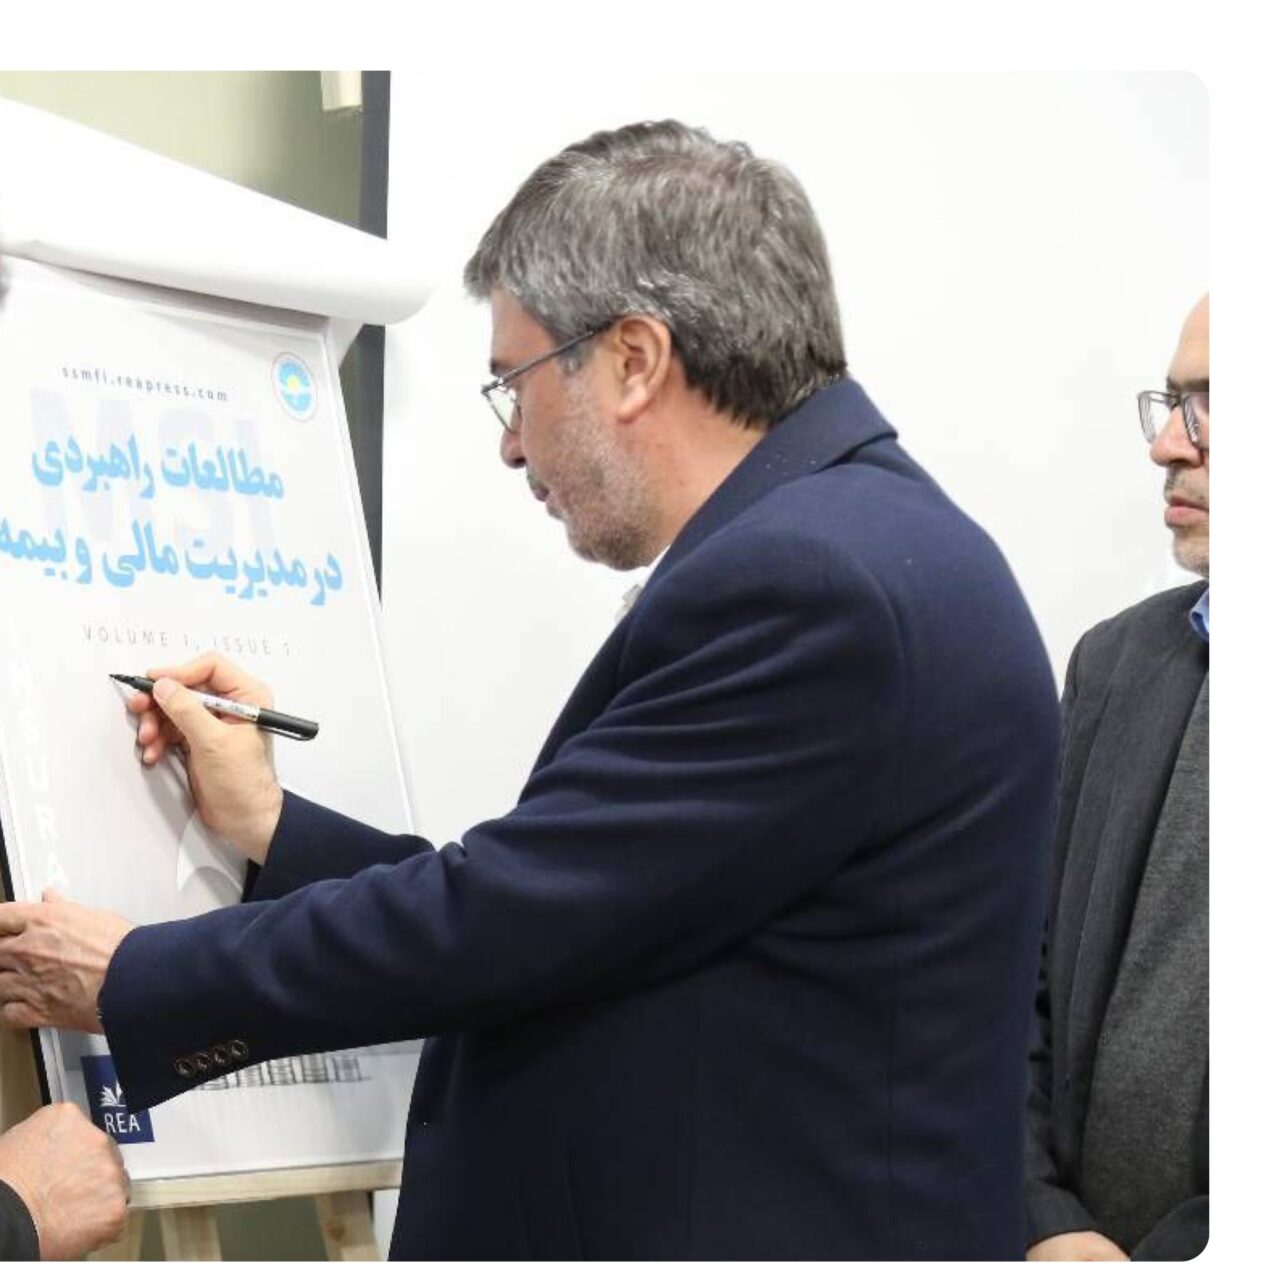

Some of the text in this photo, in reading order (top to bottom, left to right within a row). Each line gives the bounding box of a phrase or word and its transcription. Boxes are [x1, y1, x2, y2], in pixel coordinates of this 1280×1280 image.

[62, 364, 230, 403] ssmfi.reapress.com
[31, 433, 285, 500] مطالعات راهبردی
[74, 535, 93, 585] و
[101, 518, 180, 588] مالی
[185, 537, 308, 600] مدیریت
[310, 551, 344, 607] در
[104, 1112, 141, 1134] REA
